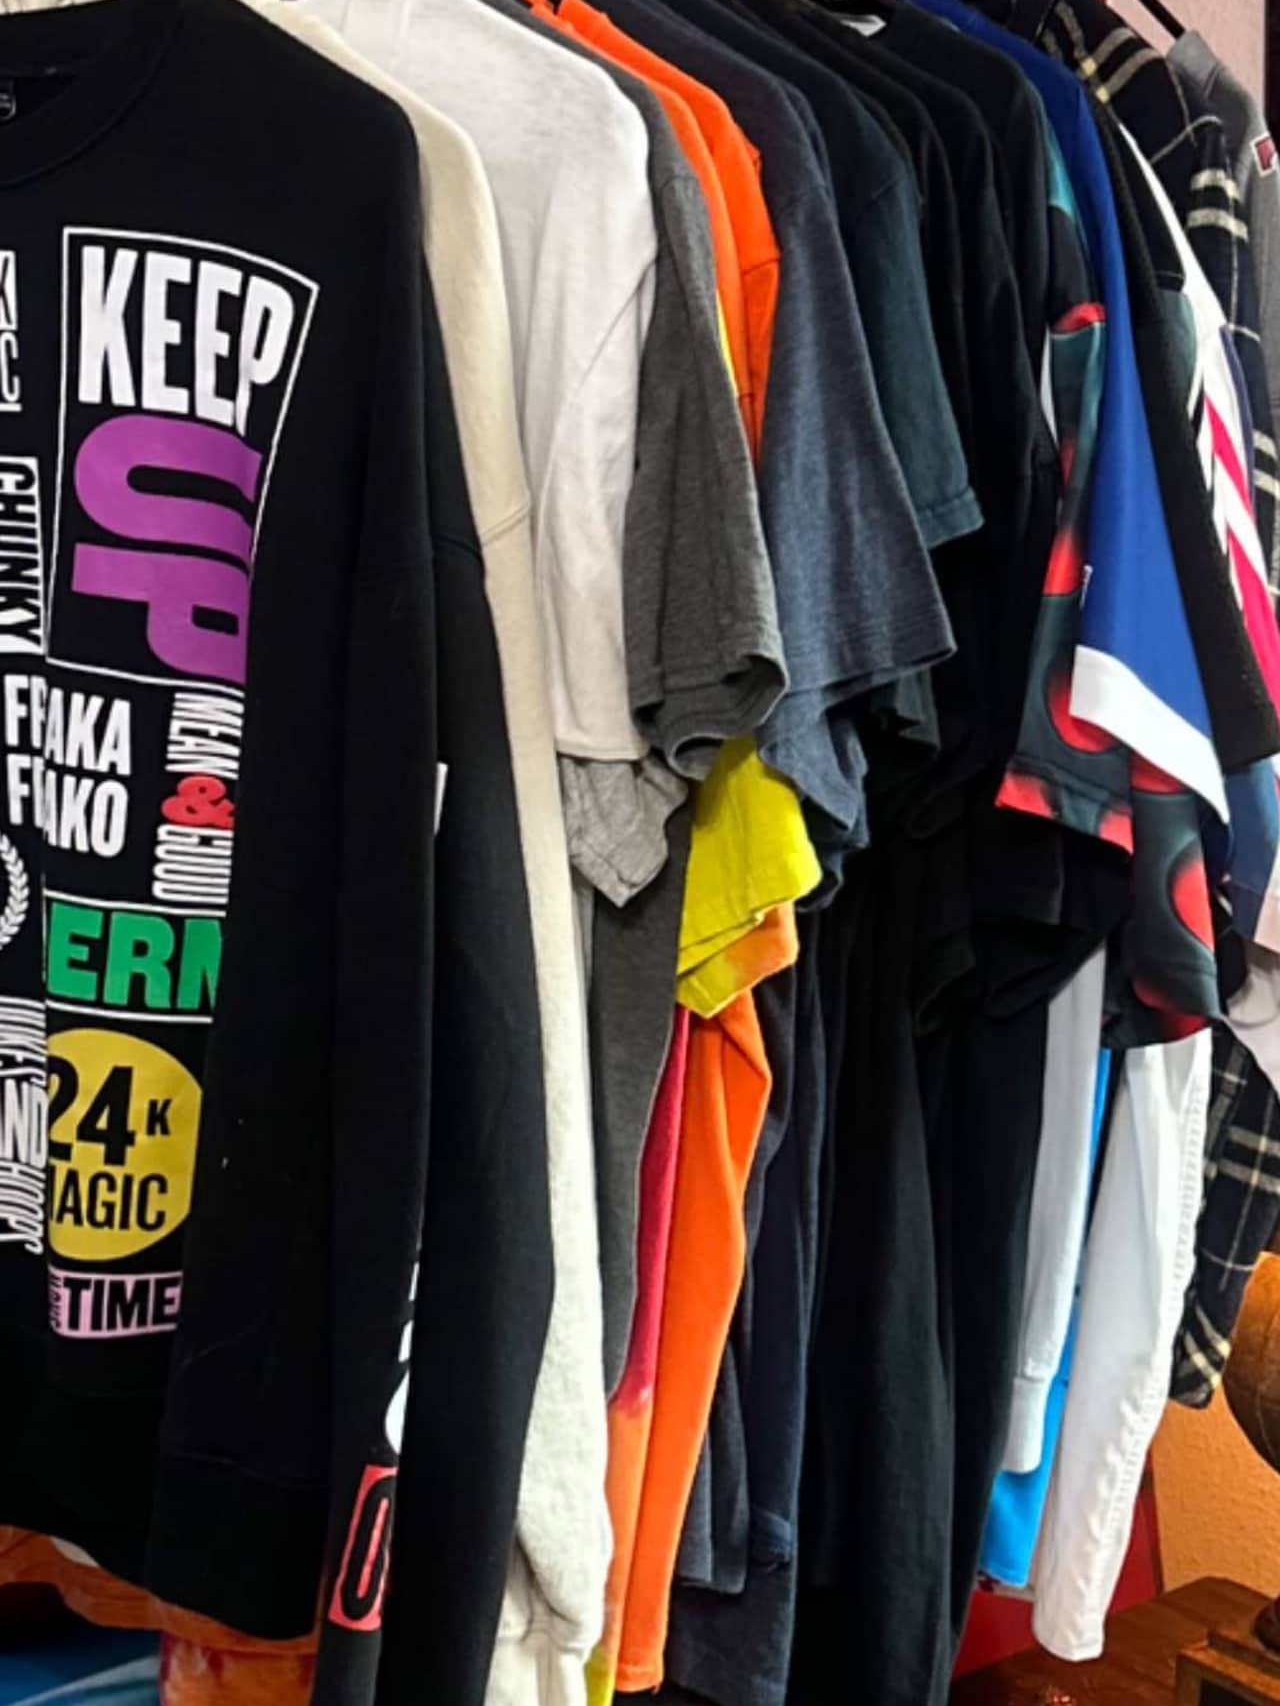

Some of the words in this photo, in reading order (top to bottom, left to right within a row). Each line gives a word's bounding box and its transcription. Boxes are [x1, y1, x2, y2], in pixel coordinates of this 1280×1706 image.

[78, 244, 295, 435] KEEP
[70, 412, 265, 686] UP
[165, 692, 245, 780] MEAN
[161, 774, 235, 831] &
[146, 1098, 173, 1137] K
[63, 1278, 182, 1332] TIME
